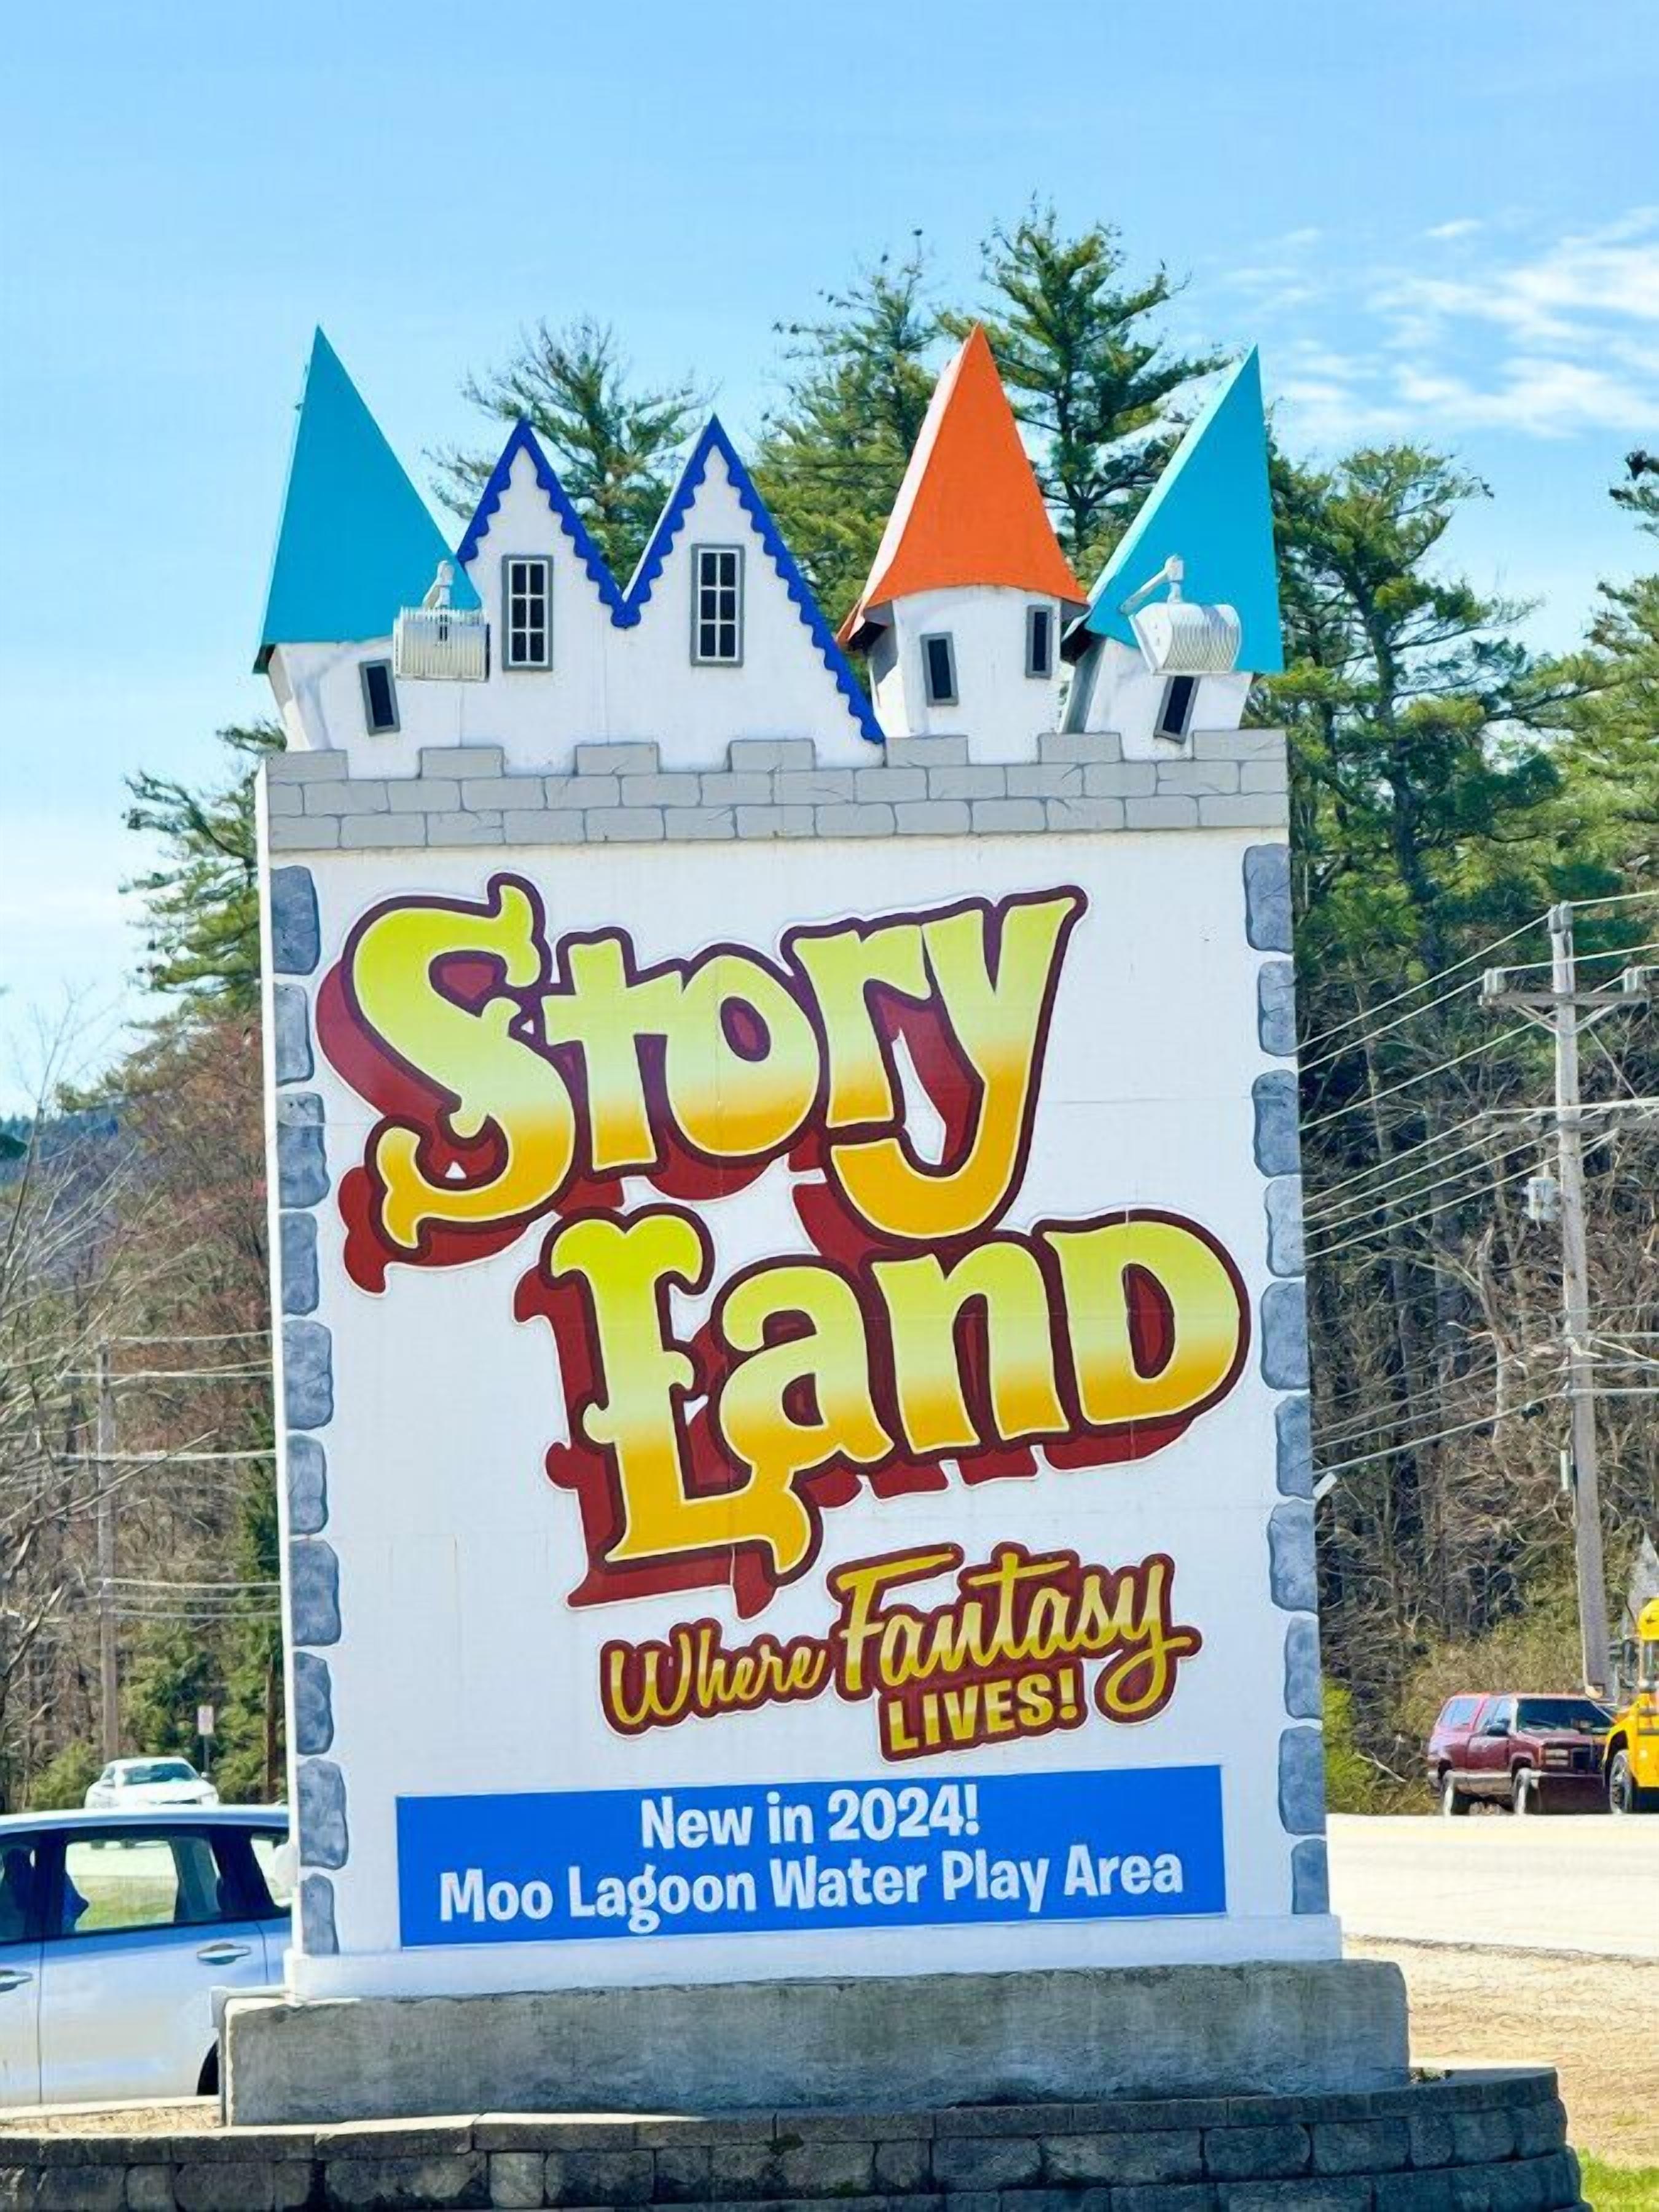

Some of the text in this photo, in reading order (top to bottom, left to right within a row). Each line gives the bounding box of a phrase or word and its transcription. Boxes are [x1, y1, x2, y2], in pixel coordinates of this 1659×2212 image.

[349, 879, 1081, 1249] Story
[608, 1551, 1193, 1725] Where Fantasy
[888, 1668, 1077, 1752] LIVES!
[642, 1784, 979, 1848] New in 2024!
[441, 1846, 1182, 1933] Moo Lagoon Water Play Area
